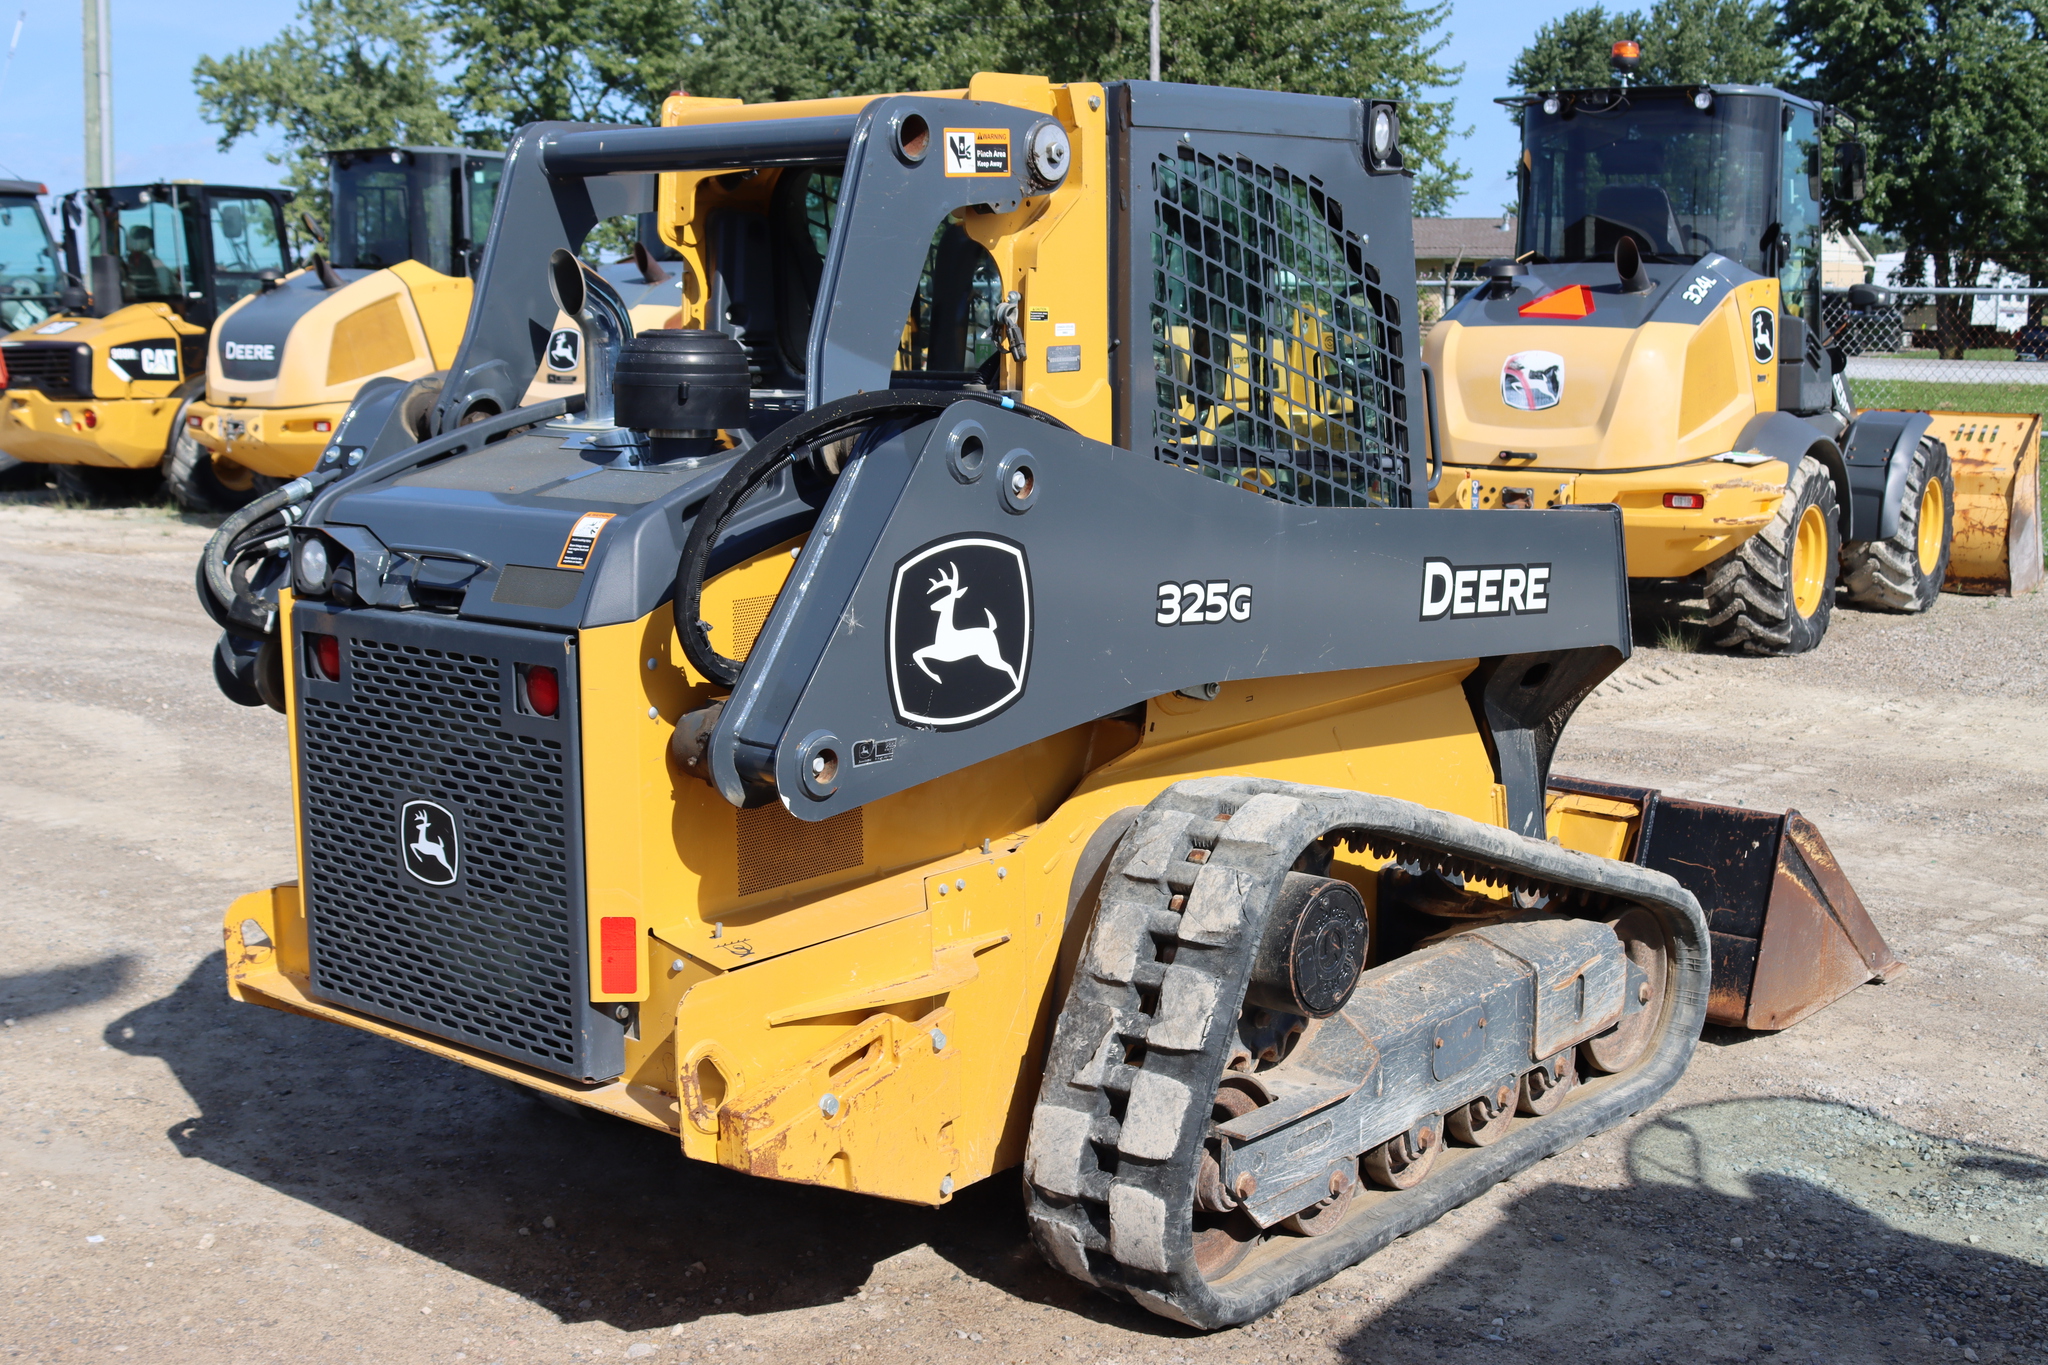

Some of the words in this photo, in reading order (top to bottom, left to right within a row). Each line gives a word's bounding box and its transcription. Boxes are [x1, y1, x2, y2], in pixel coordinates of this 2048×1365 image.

[976, 149, 993, 158] Pinch
[993, 149, 1007, 158] Area
[976, 160, 990, 168] Keep
[989, 160, 1003, 168] Away
[1681, 274, 1718, 305] 324L
[140, 347, 177, 375] CAT
[225, 341, 275, 361] DEERE
[1422, 561, 1550, 618] DEERE
[1156, 582, 1252, 626] 325G
